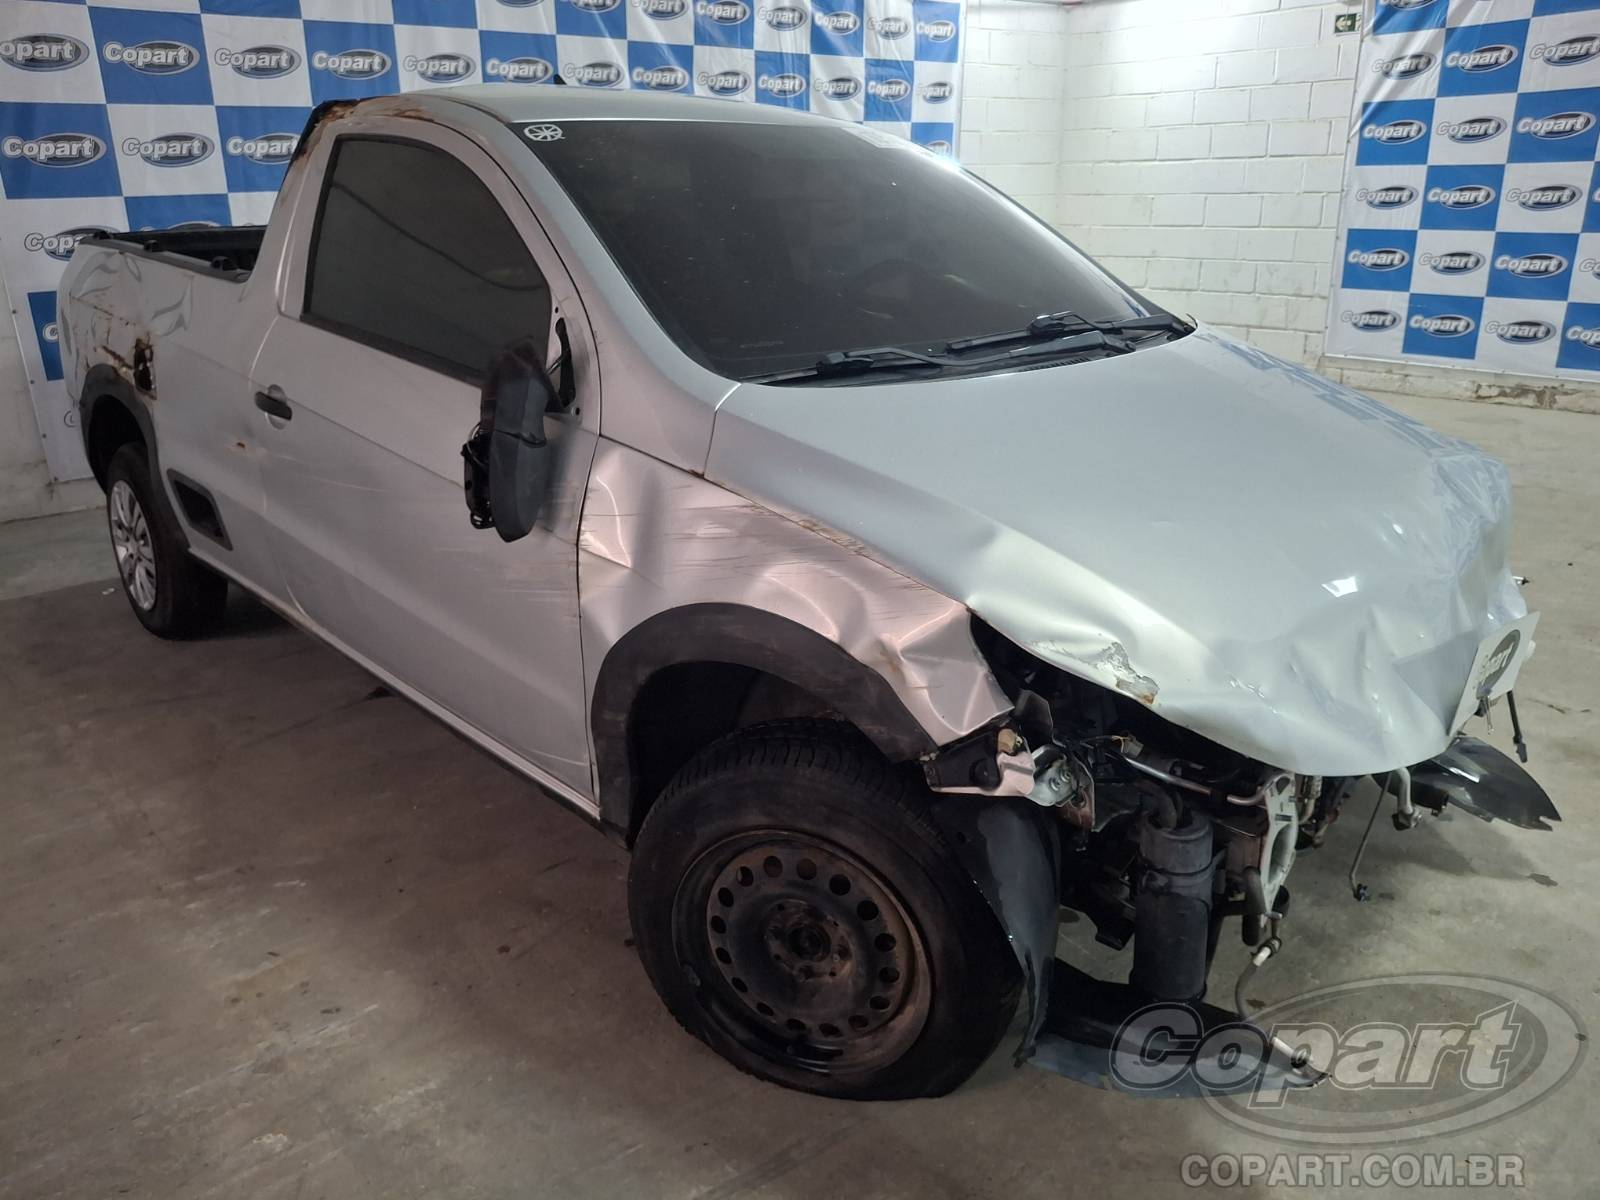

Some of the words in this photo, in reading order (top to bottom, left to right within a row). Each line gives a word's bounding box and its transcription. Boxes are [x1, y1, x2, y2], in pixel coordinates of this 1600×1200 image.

[697, 1, 743, 20] Copart
[758, 7, 799, 25] Copart
[814, 12, 855, 29] Copart
[916, 22, 952, 38] Copart
[0, 40, 76, 64] opart
[103, 42, 190, 66] Copart
[215, 48, 290, 69] Copart
[1446, 47, 1511, 69] Copart
[1530, 38, 1600, 61] Copart
[312, 53, 382, 72] Copart
[403, 54, 467, 75] Copart
[486, 58, 545, 78] Copart
[563, 63, 618, 81] Copart
[1372, 54, 1428, 73] Copart
[632, 65, 683, 84] Copart
[698, 71, 744, 90] Copart
[758, 75, 801, 92] Copart
[815, 78, 855, 95] Copart
[868, 81, 906, 98] Copart
[1363, 121, 1420, 139] Copart
[1437, 117, 1503, 138] Copart
[1517, 114, 1588, 134] Copart
[2, 136, 96, 160] Copart
[122, 138, 202, 158] Copart
[1356, 186, 1413, 204] Copart
[1427, 185, 1487, 204] Copart
[1507, 186, 1573, 205] Copart
[24, 232, 80, 255] Cop
[1348, 249, 1403, 267] Copart
[1419, 252, 1476, 269] Copart
[1495, 255, 1560, 275] Copart
[1342, 311, 1394, 327] Copart
[1409, 314, 1467, 333] Copart
[1485, 321, 1547, 341] Copart
[1566, 326, 1600, 344] Cop
